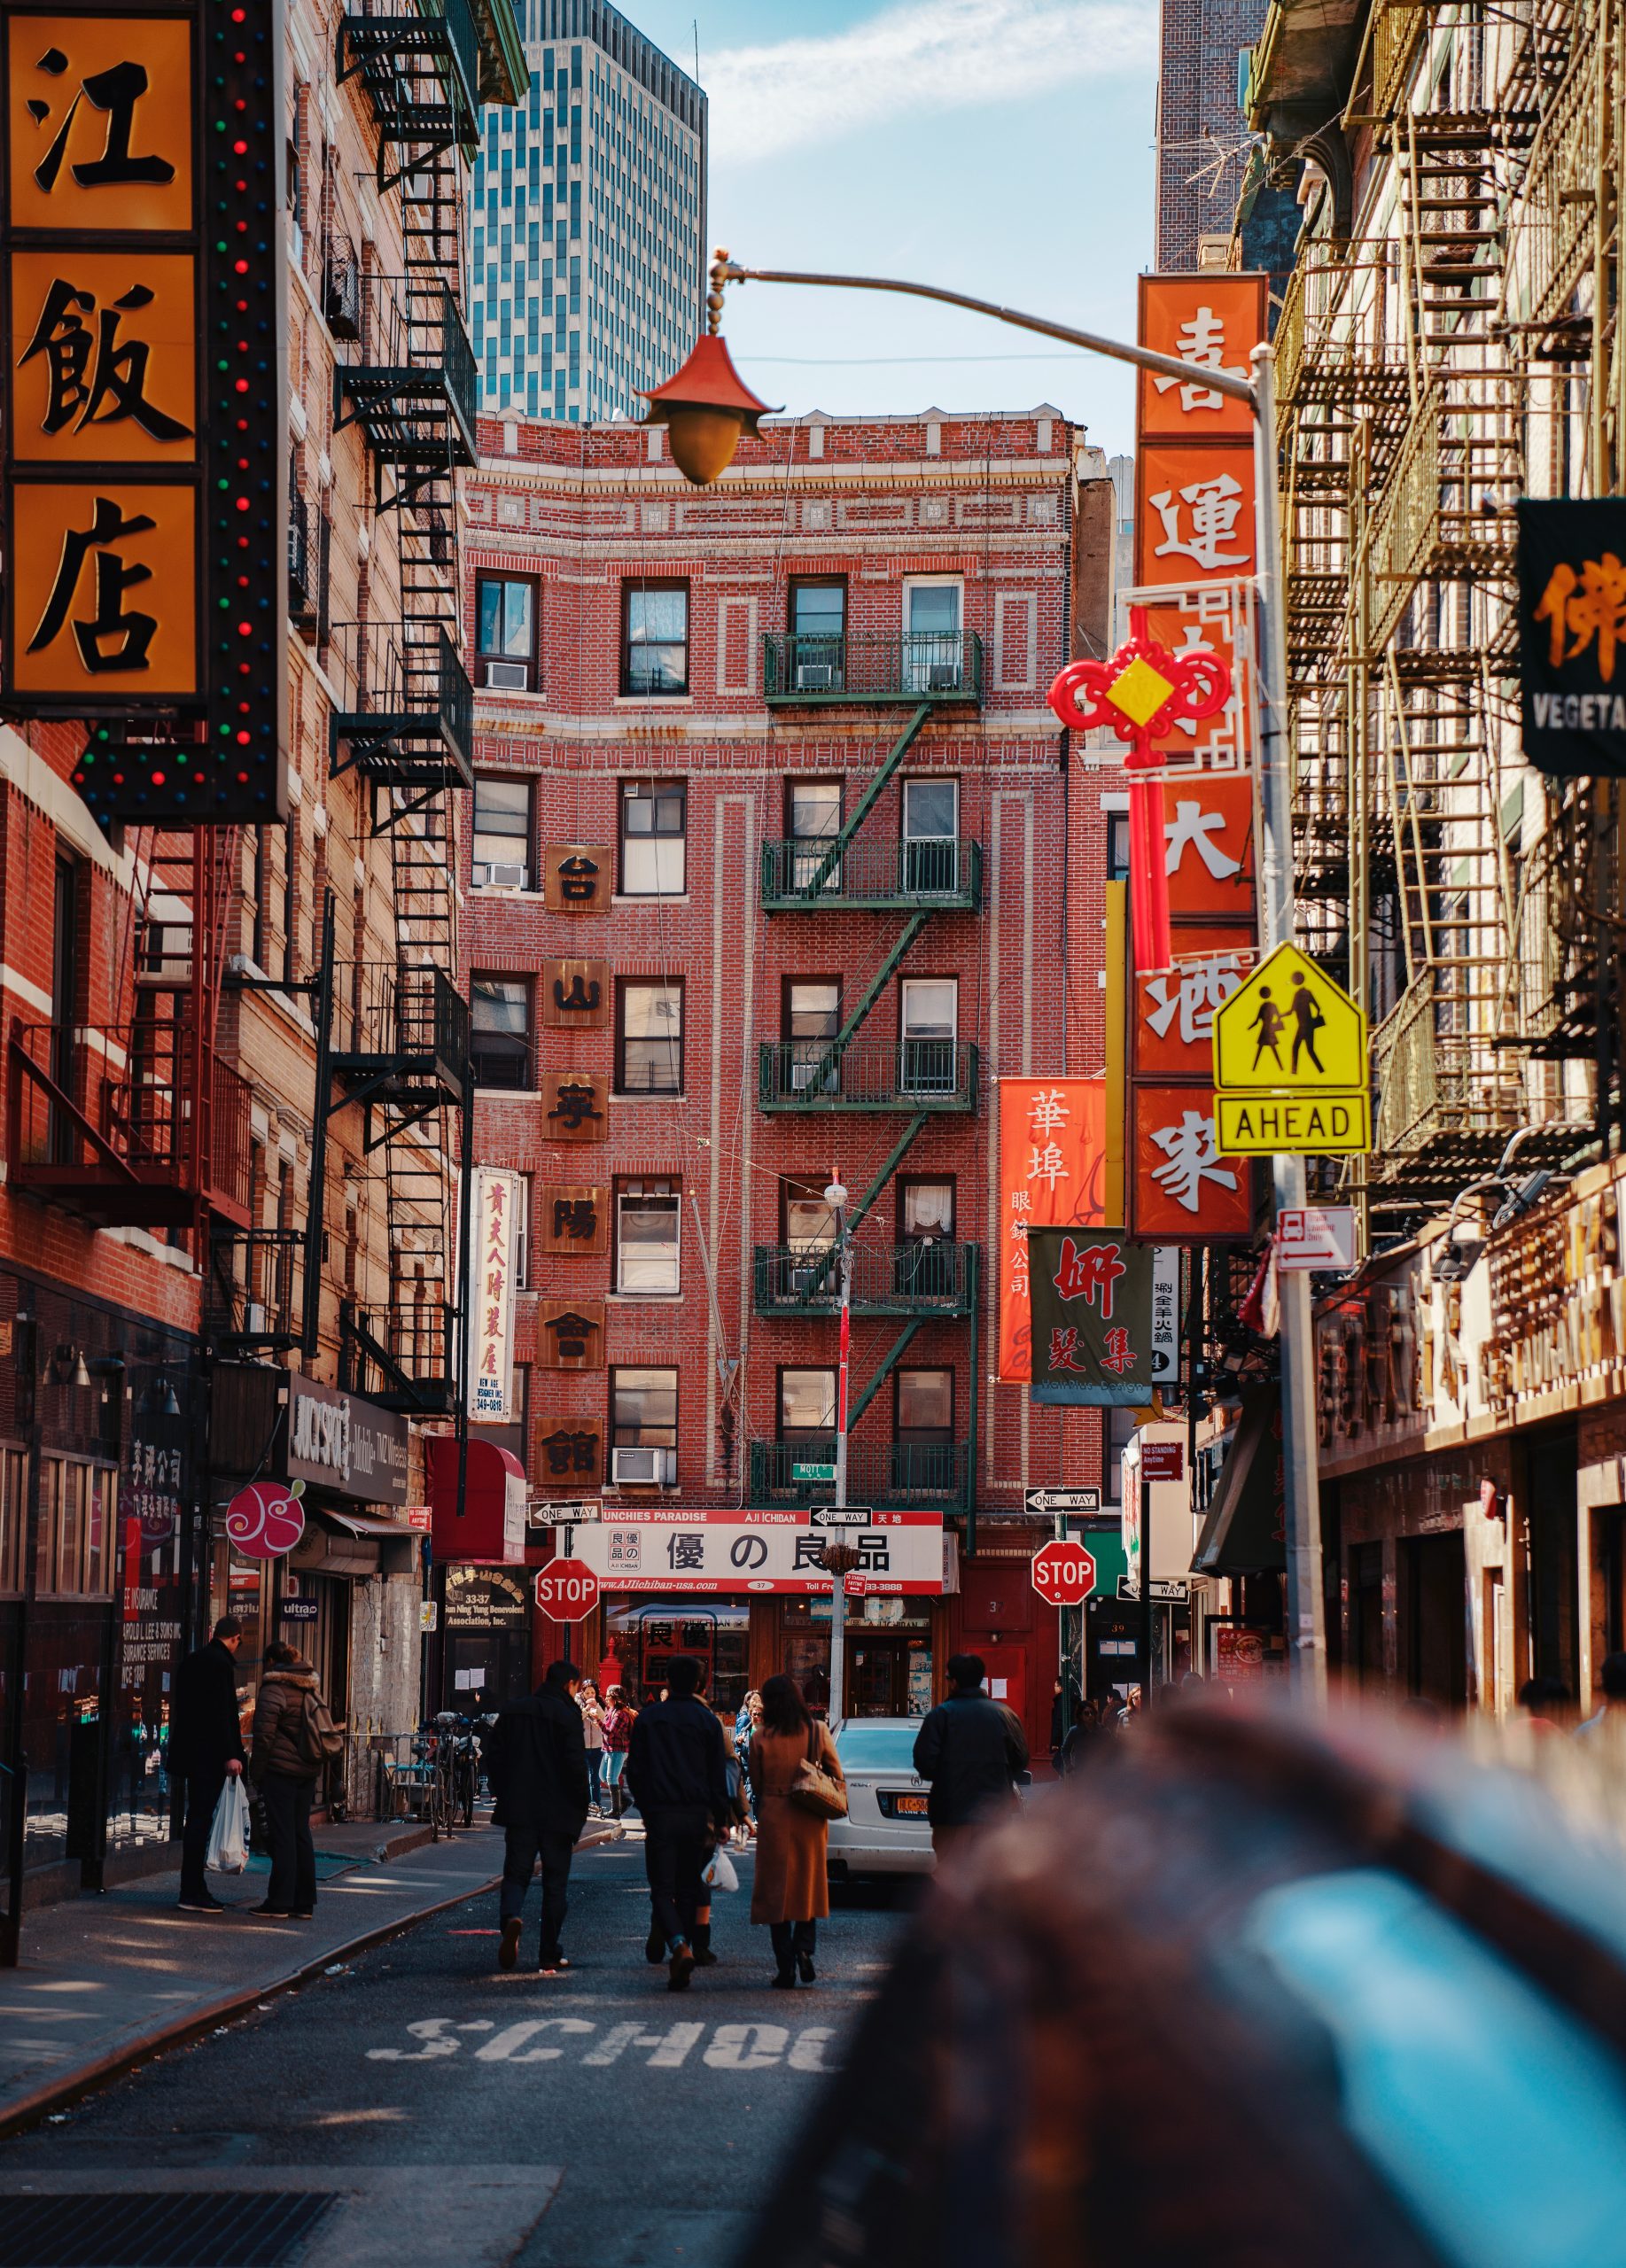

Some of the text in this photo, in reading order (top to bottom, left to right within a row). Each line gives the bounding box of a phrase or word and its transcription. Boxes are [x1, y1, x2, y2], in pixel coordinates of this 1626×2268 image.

[17, 47, 196, 674] 江飯店
[1145, 307, 1250, 1212] 喜運大酒家
[1235, 1106, 1350, 1139] AHEAD
[1026, 1089, 1070, 1192] 華埠
[1009, 1190, 1033, 1298] 眼鏡公司
[481, 1183, 507, 1374] 貴夫人時裝屋
[1154, 1283, 1172, 1343] 涮全羊火鍋
[1101, 1380, 1144, 1393] Design
[1035, 1495, 1093, 1504] ONE WAY
[541, 1508, 594, 1519] ONE WAY
[603, 1511, 707, 1521] UNCHIES PARADISE
[744, 1512, 796, 1523] AJI ICHIBAN
[877, 1514, 902, 1524] 天地
[1036, 1561, 1092, 1585] STOP
[540, 1578, 595, 1601] STOP
[599, 1580, 718, 1590] ww.AJIichiban-usa.com
[1161, 1586, 1181, 1596] WAY
[465, 1595, 490, 1604] 33-37
[456, 1604, 472, 1616] Ning
[473, 1604, 489, 1616] Yung
[490, 1604, 525, 1614] Benevolent
[447, 1617, 507, 1627] Association, Inc.
[1111, 1624, 1124, 1633] 39
[123, 1622, 139, 1640] AROLD
[123, 1643, 170, 1662] SURANCE SERVICES
[121, 1666, 132, 1683] NCE
[364, 2017, 848, 2071] SCHO
